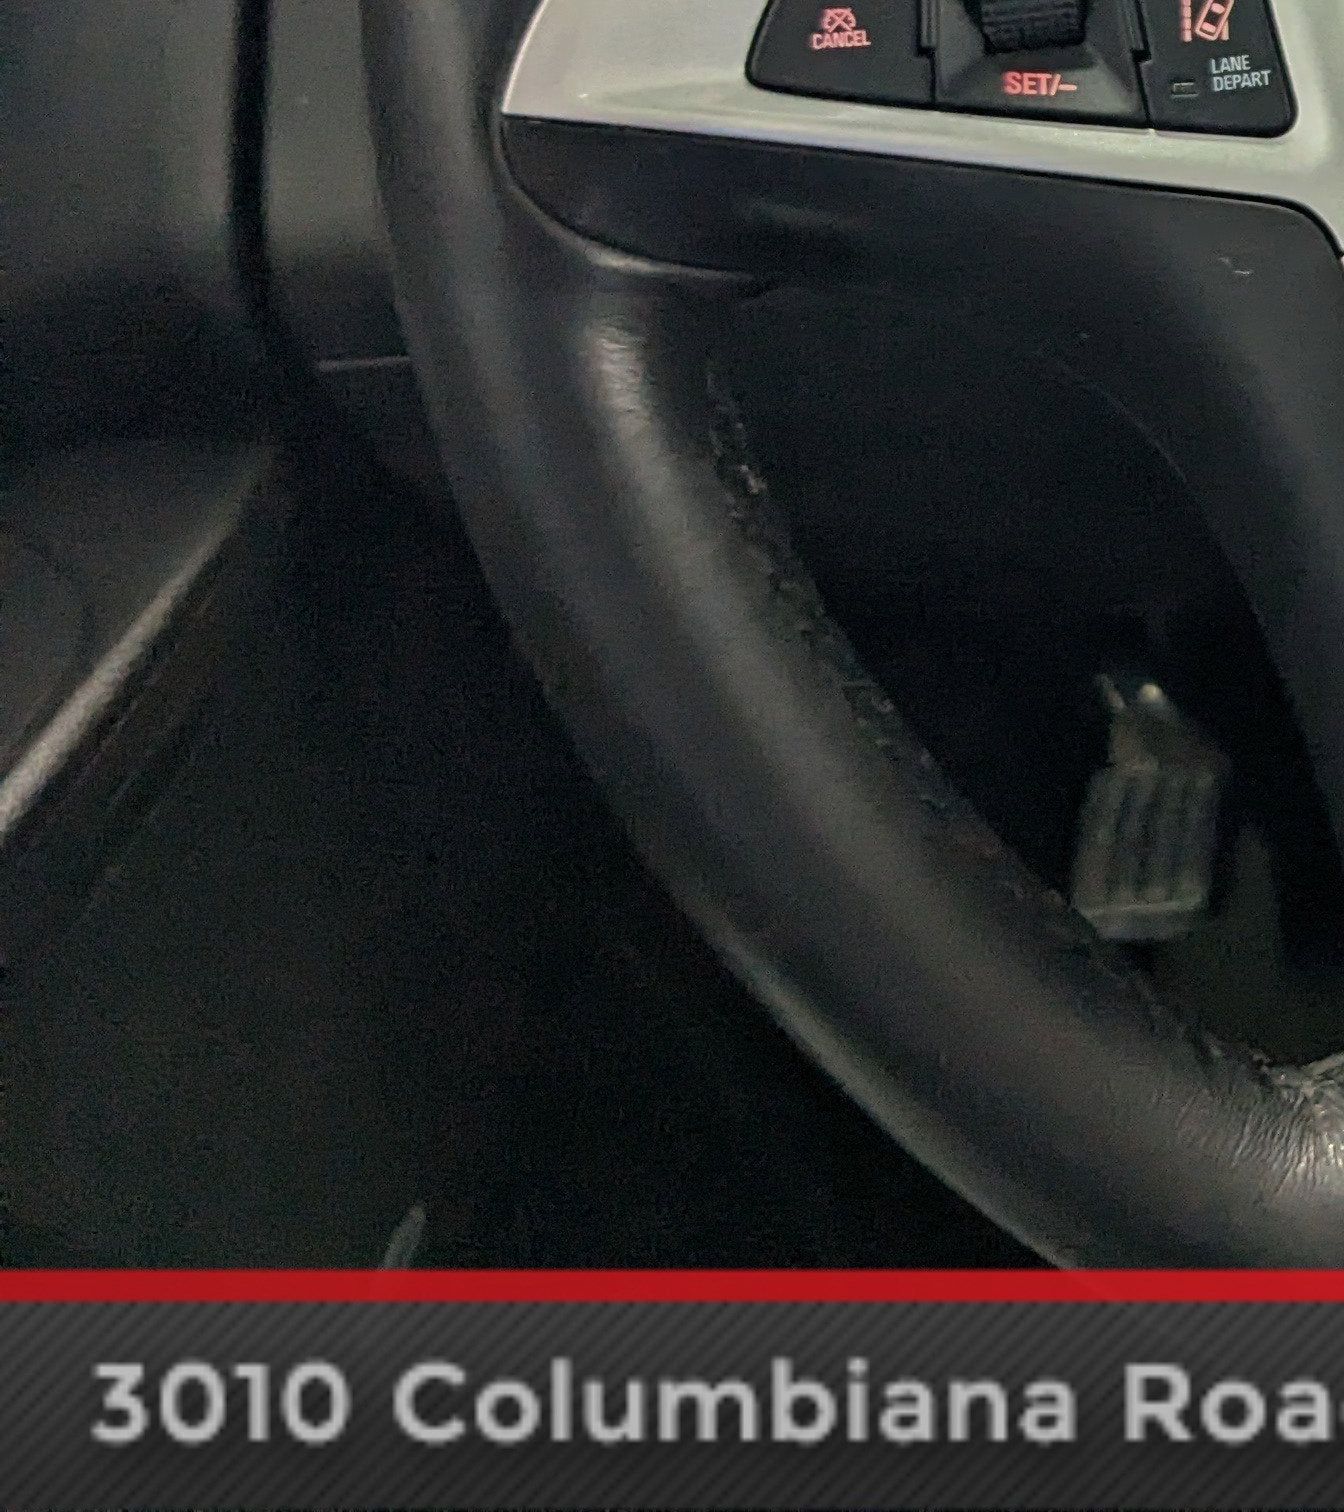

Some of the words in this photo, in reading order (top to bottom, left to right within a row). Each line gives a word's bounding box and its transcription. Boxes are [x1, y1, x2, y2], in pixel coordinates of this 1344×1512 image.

[810, 28, 873, 52] CANCEL
[1211, 54, 1252, 75] LANE
[1212, 68, 1274, 94] DEPART
